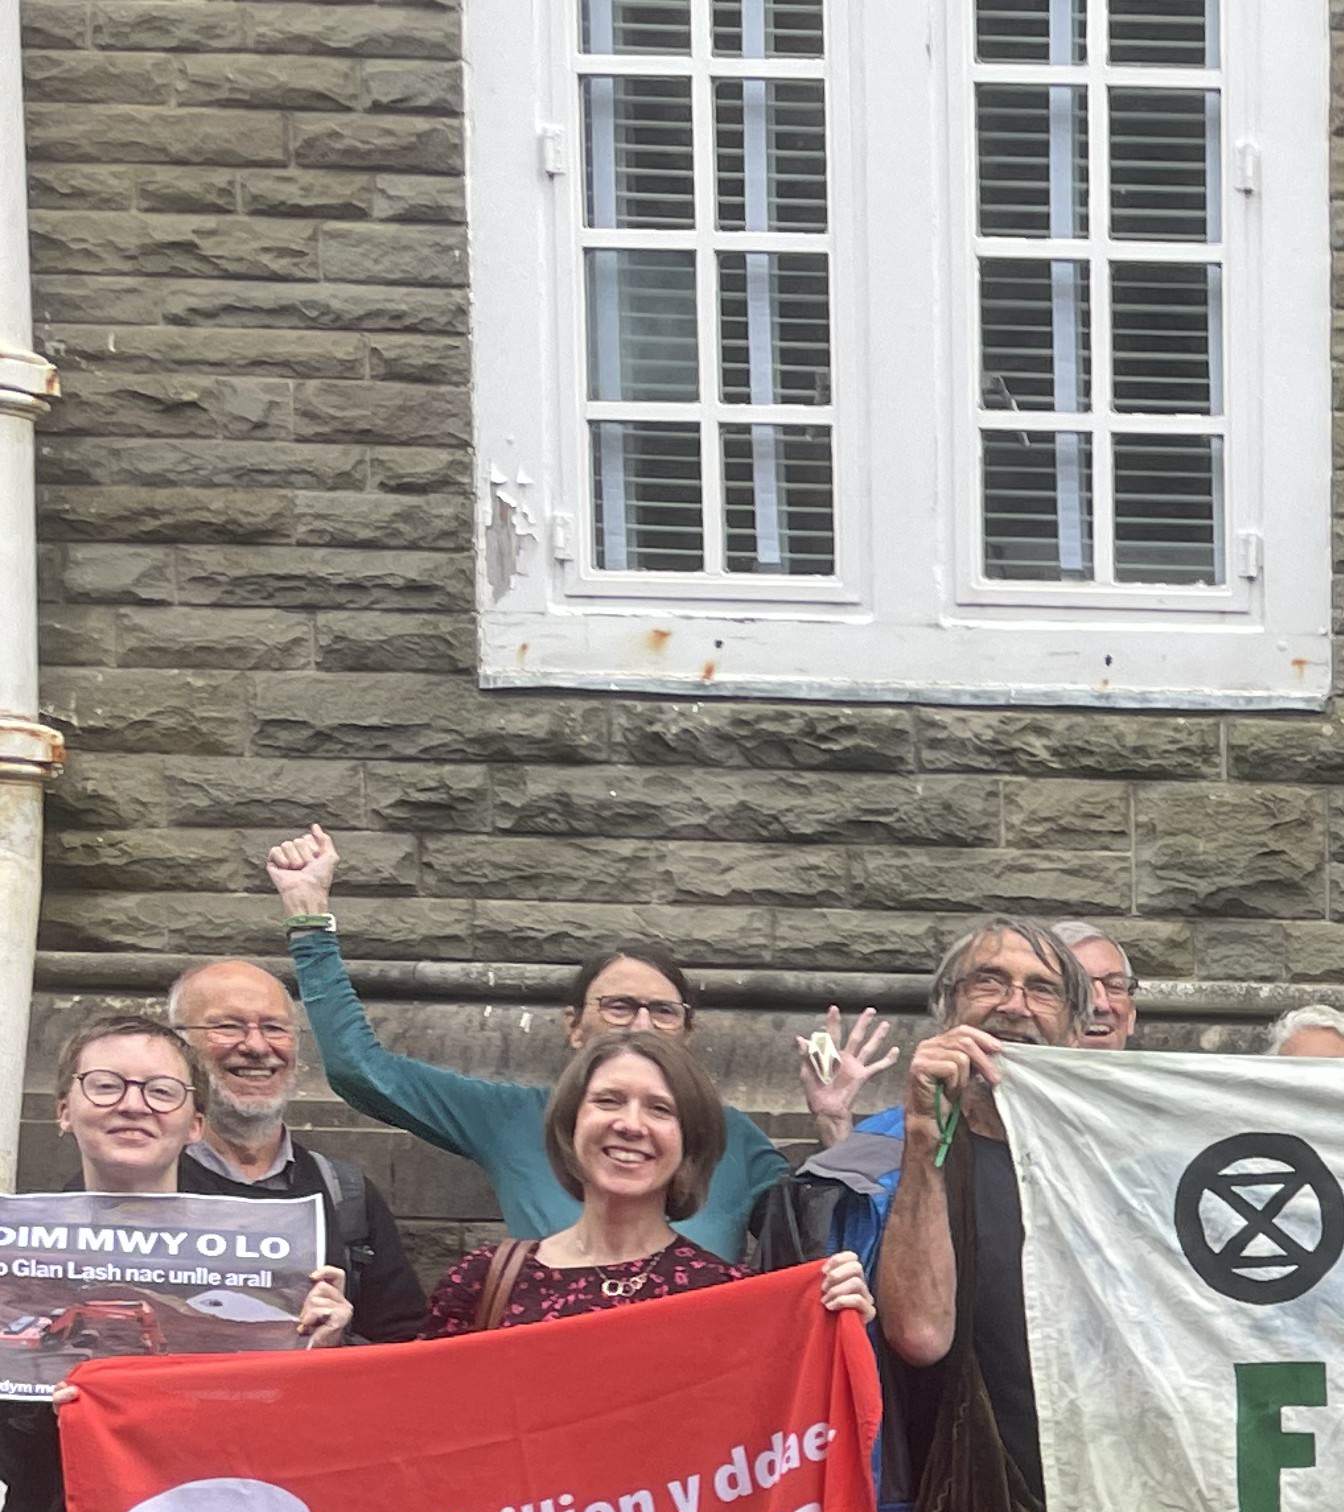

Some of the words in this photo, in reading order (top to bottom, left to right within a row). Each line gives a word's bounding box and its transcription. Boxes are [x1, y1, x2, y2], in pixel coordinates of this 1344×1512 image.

[77, 1228, 187, 1255] MWY
[196, 1234, 226, 1257] O
[235, 1236, 290, 1259] LO
[12, 1258, 63, 1279] Glan
[68, 1261, 121, 1282] Lash
[125, 1266, 164, 1283] nac
[169, 1267, 220, 1286] unlle
[226, 1271, 272, 1288] arall
